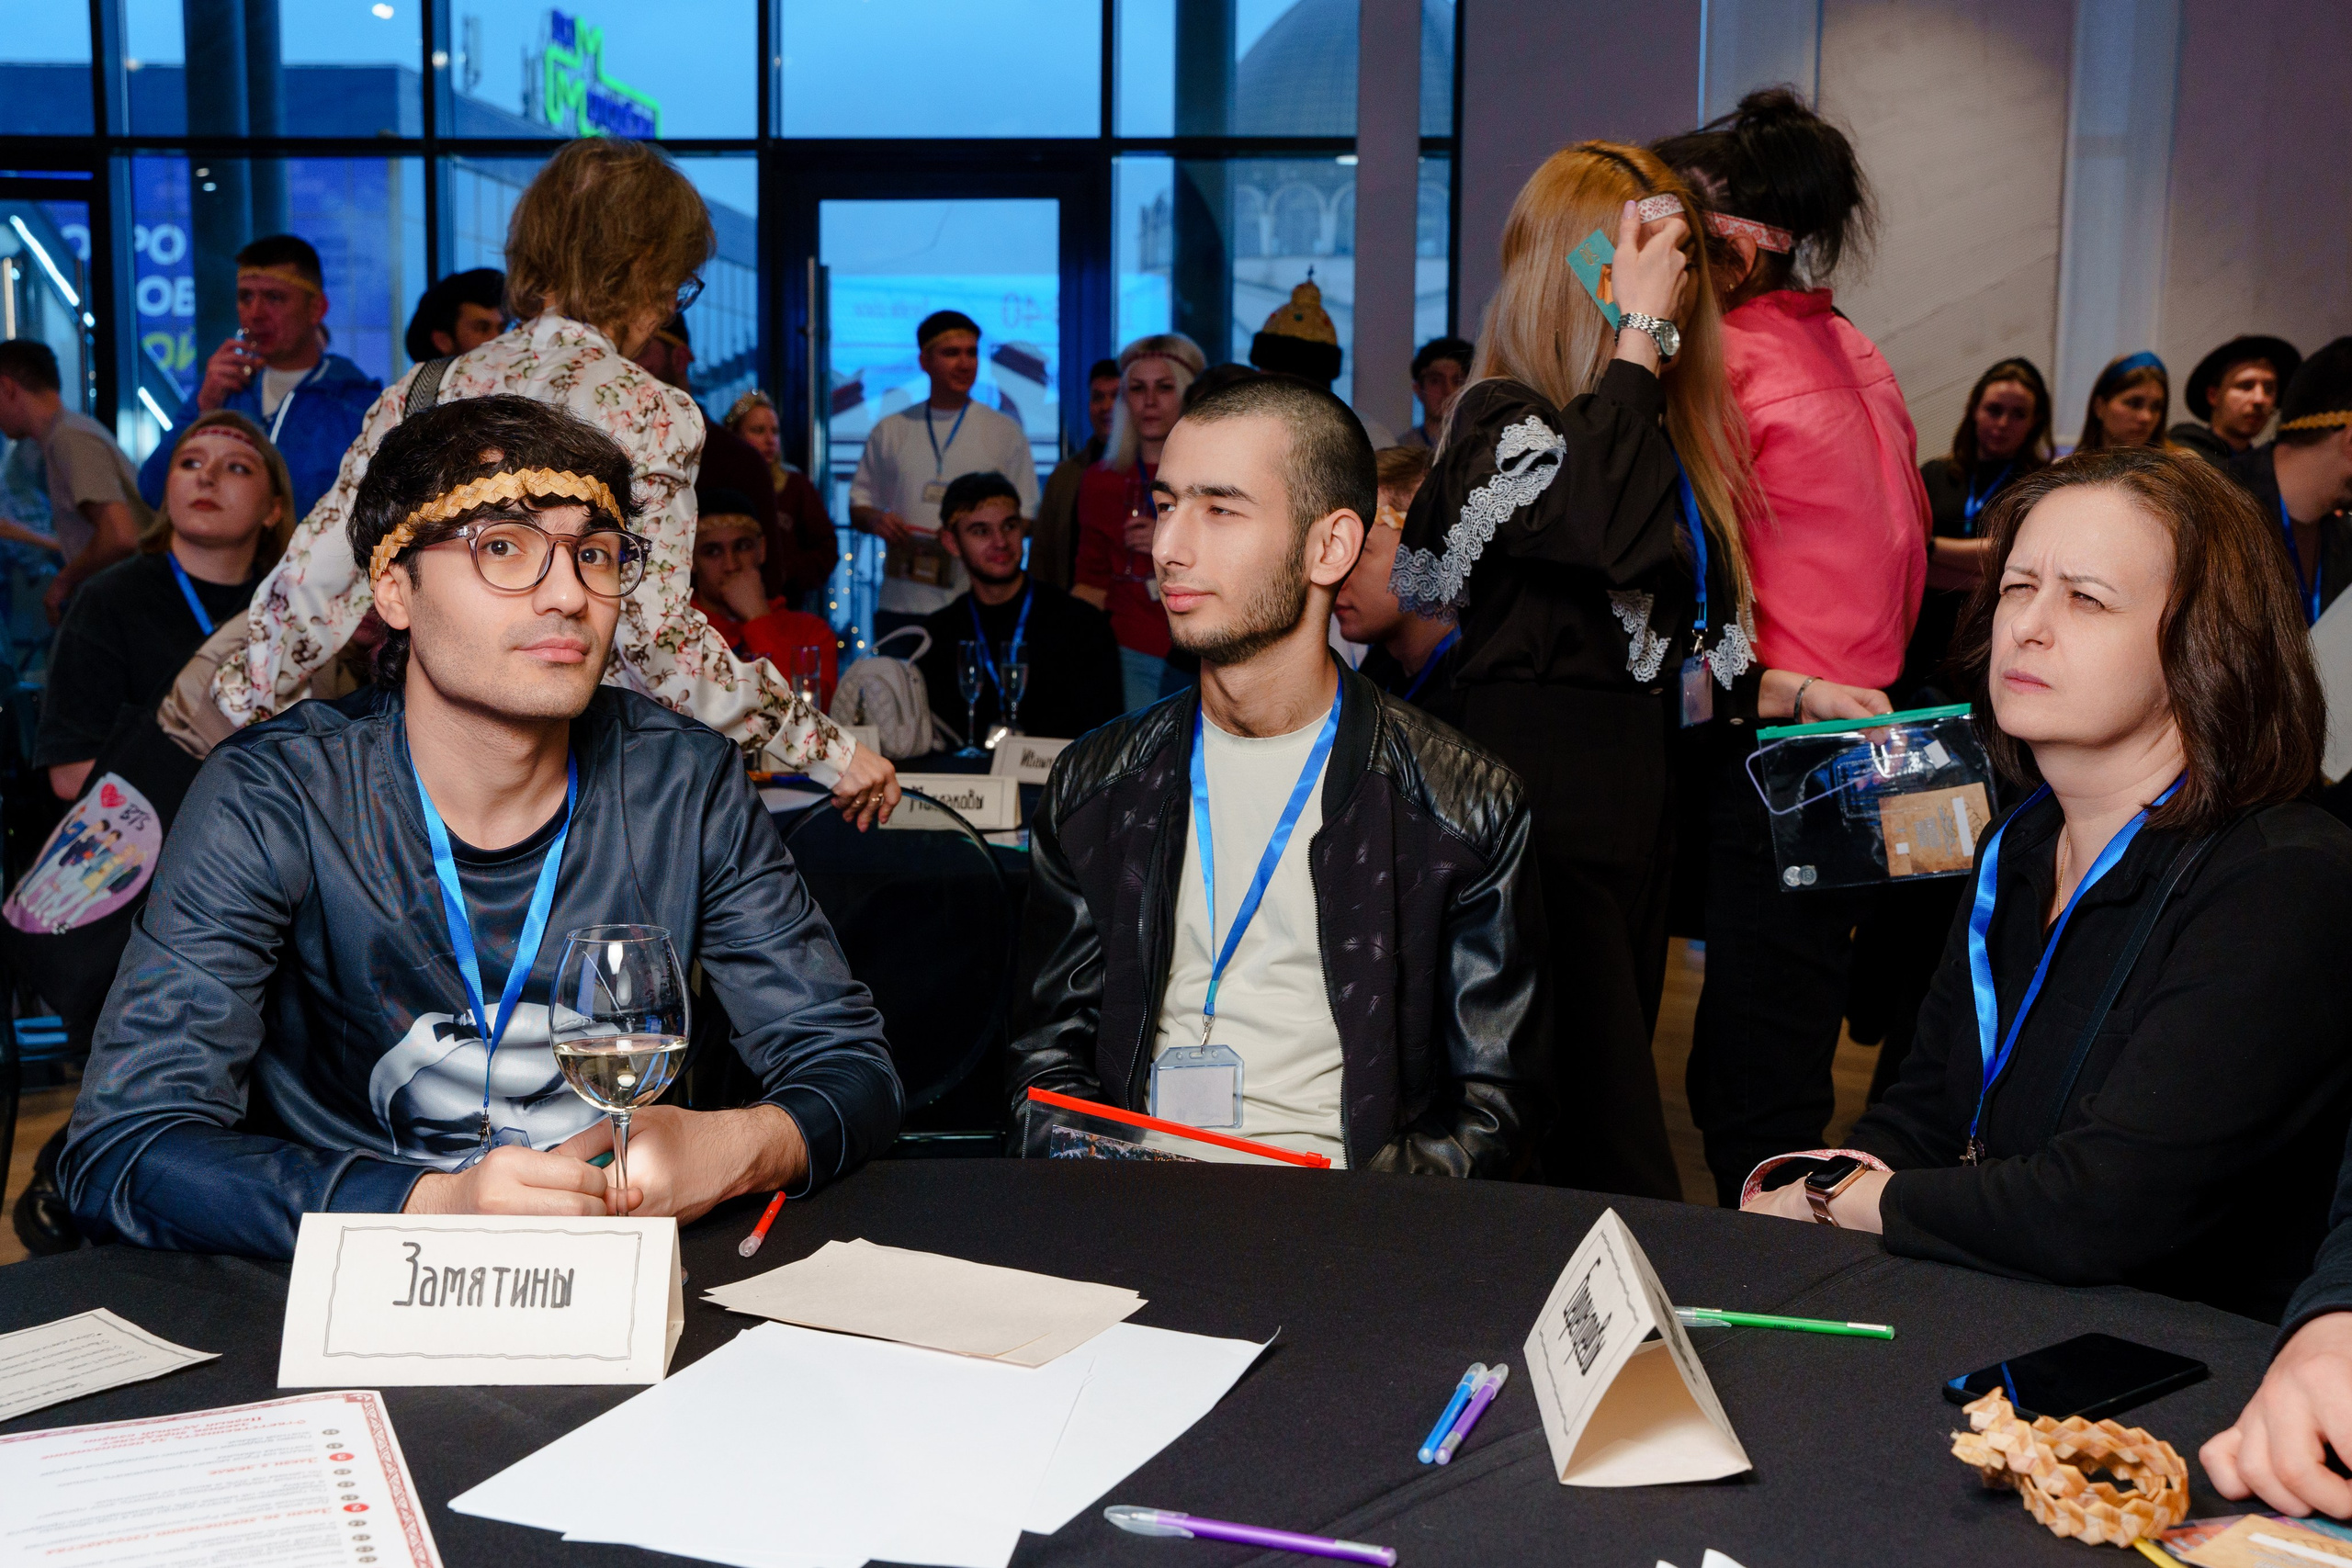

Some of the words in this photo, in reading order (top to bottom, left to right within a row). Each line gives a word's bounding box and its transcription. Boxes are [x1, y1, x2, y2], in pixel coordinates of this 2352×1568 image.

[119, 803, 152, 831] BTS
[392, 1241, 575, 1309] Замятины
[1558, 1256, 1612, 1376] Берендеевы
